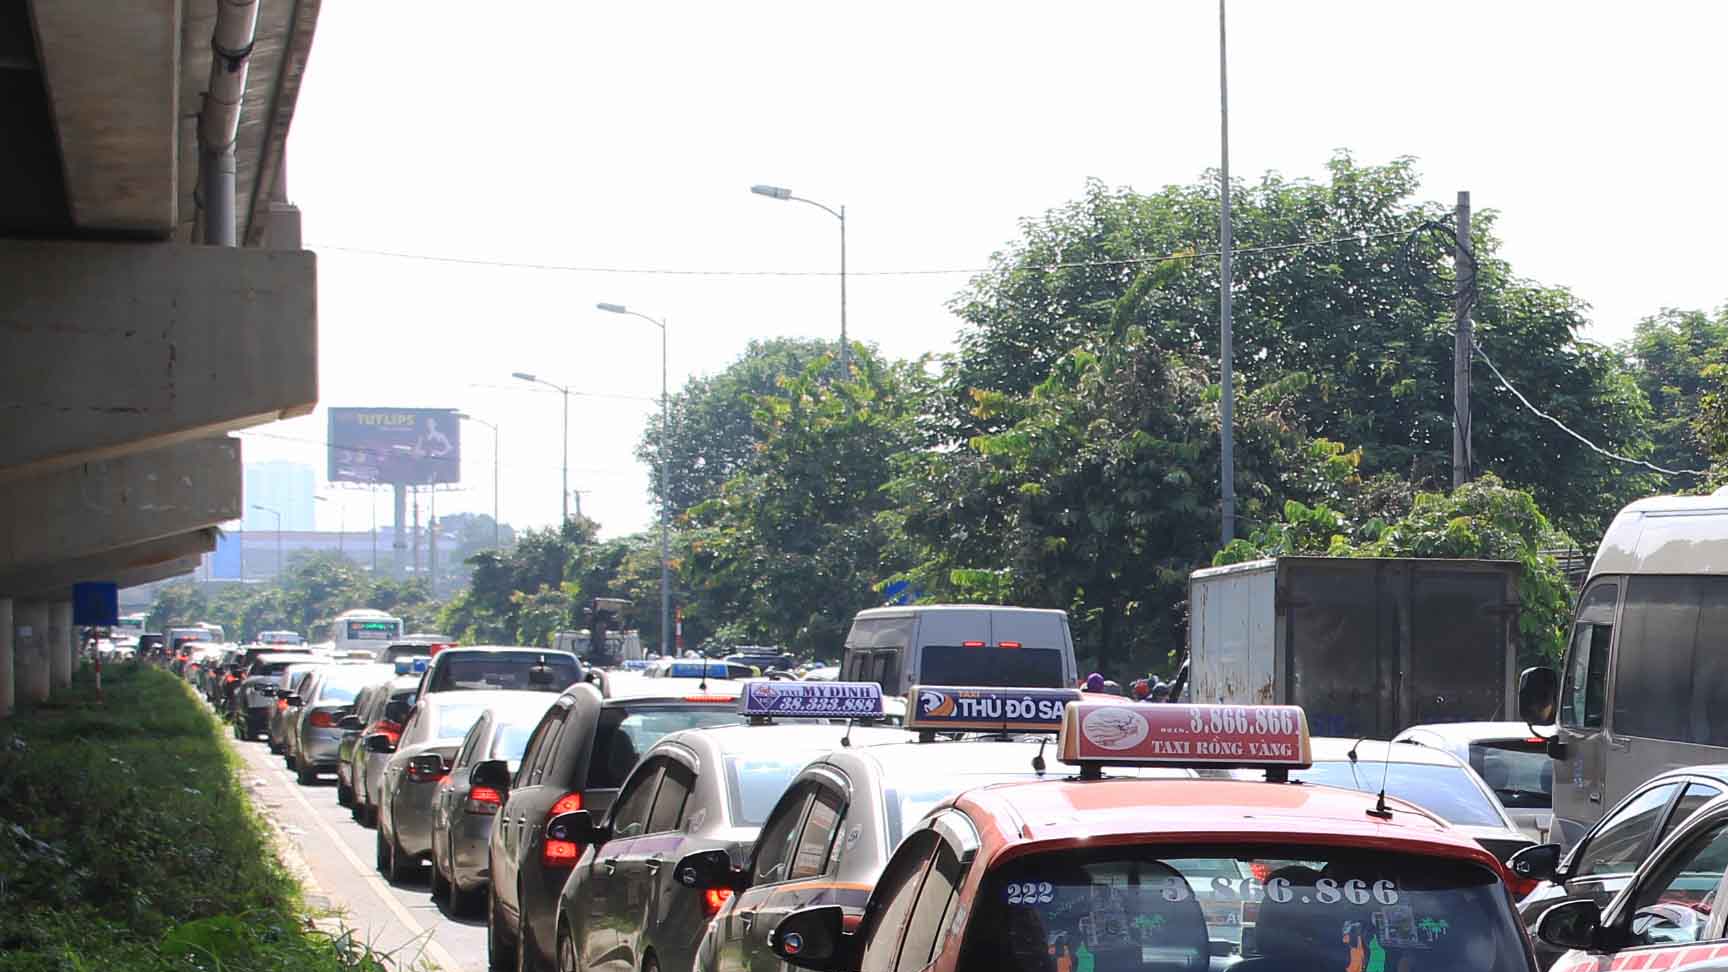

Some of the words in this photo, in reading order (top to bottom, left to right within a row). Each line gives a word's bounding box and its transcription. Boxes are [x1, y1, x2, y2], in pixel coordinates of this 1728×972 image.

[780, 697, 876, 711] 38.333.888
[959, 694, 1002, 718] THỦ
[1005, 696, 1036, 719] ĐÔ
[1038, 701, 1065, 720] SA
[1151, 740, 1191, 754] TAXI
[1007, 881, 1054, 904] 222
